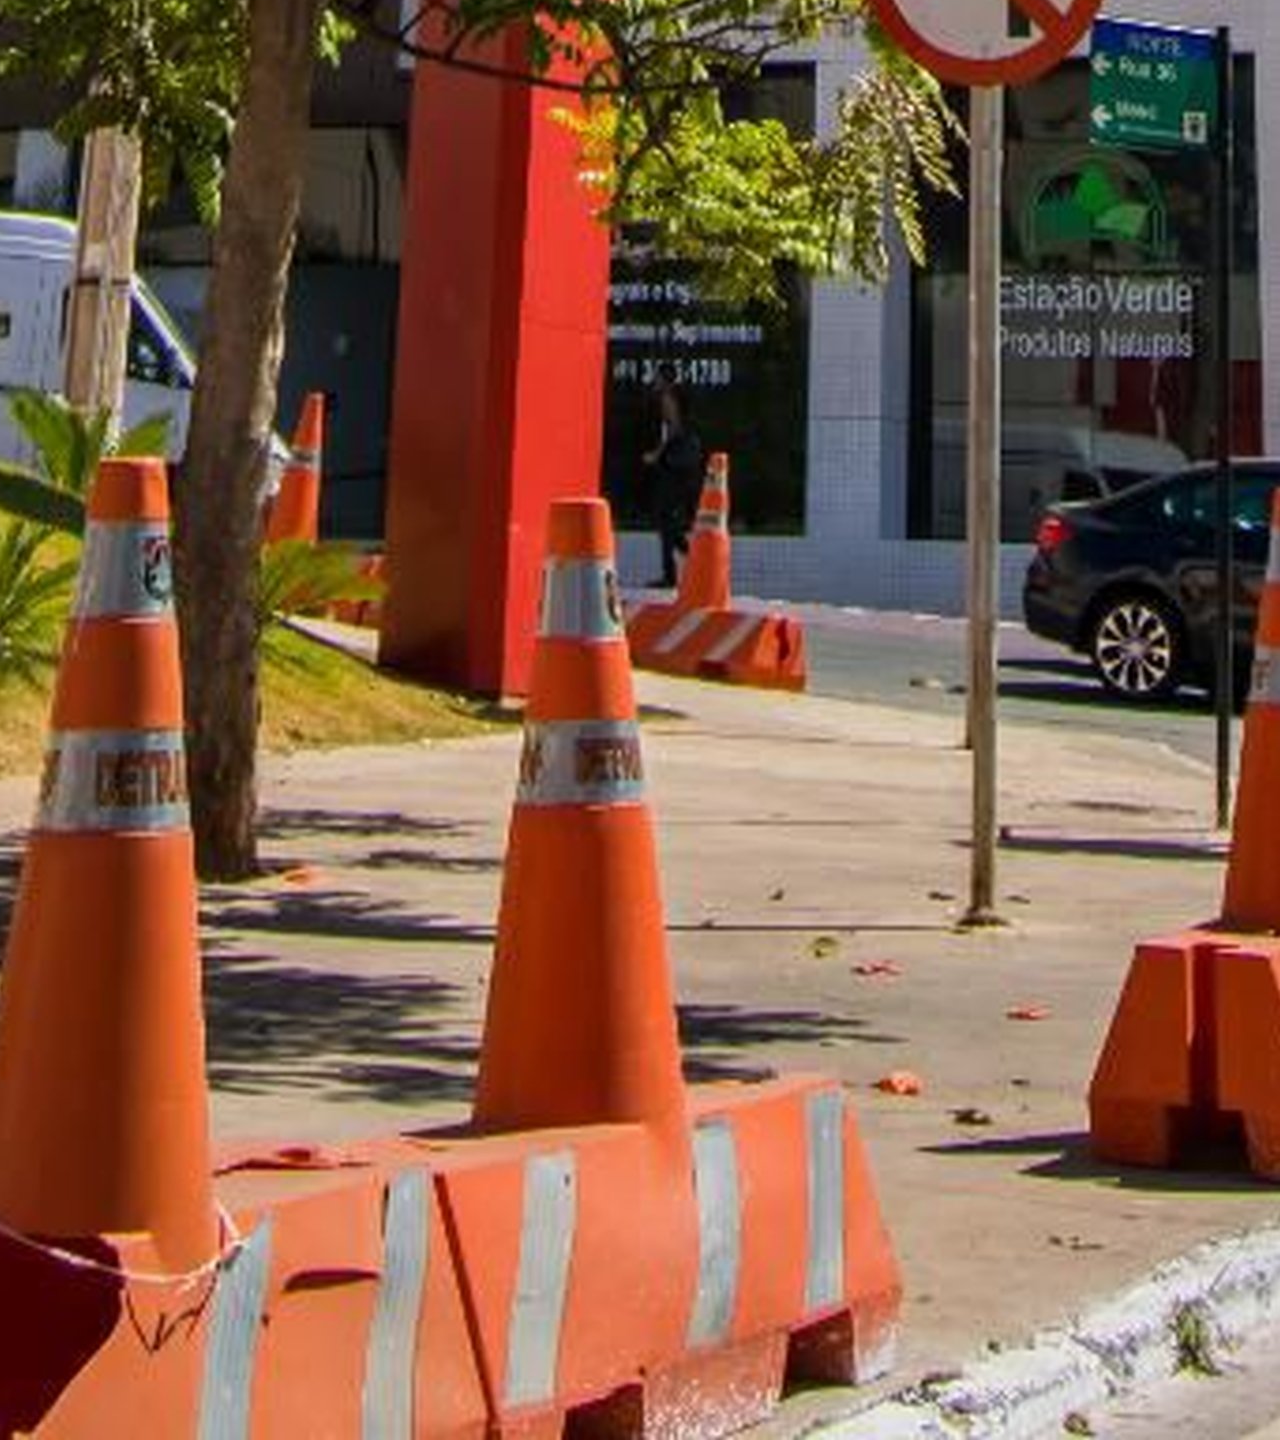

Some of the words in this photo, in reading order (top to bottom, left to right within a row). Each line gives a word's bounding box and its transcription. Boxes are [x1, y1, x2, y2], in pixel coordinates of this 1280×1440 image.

[1000, 276, 1103, 319] Estação
[1104, 276, 1193, 312] Verde
[1000, 327, 1091, 357] Produtos
[1099, 329, 1193, 358] Naturais
